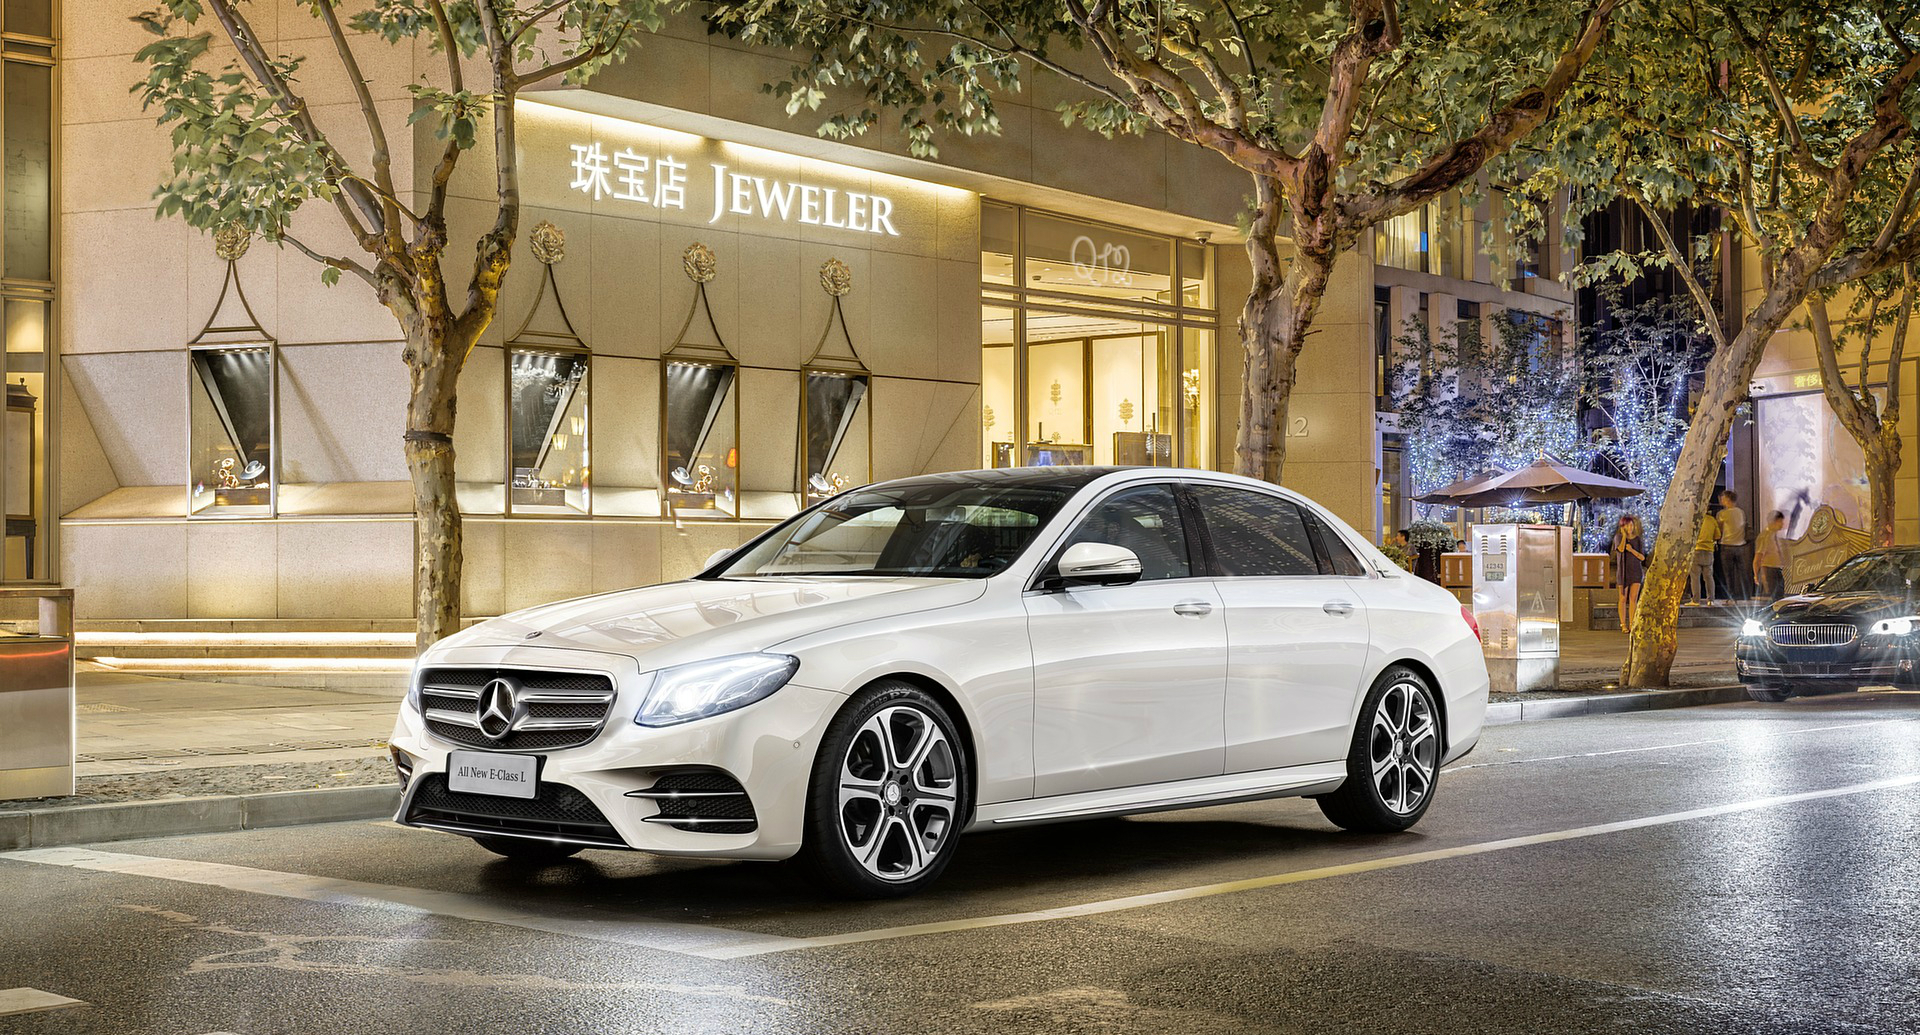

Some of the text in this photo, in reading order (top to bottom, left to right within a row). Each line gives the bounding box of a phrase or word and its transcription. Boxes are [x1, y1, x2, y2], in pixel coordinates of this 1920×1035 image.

[569, 142, 686, 210] 珠宝店
[708, 163, 899, 236] JEWELER
[1794, 374, 1822, 388] 奢侈
[889, 691, 910, 700] P7
[458, 766, 527, 783] All New E-Class L
